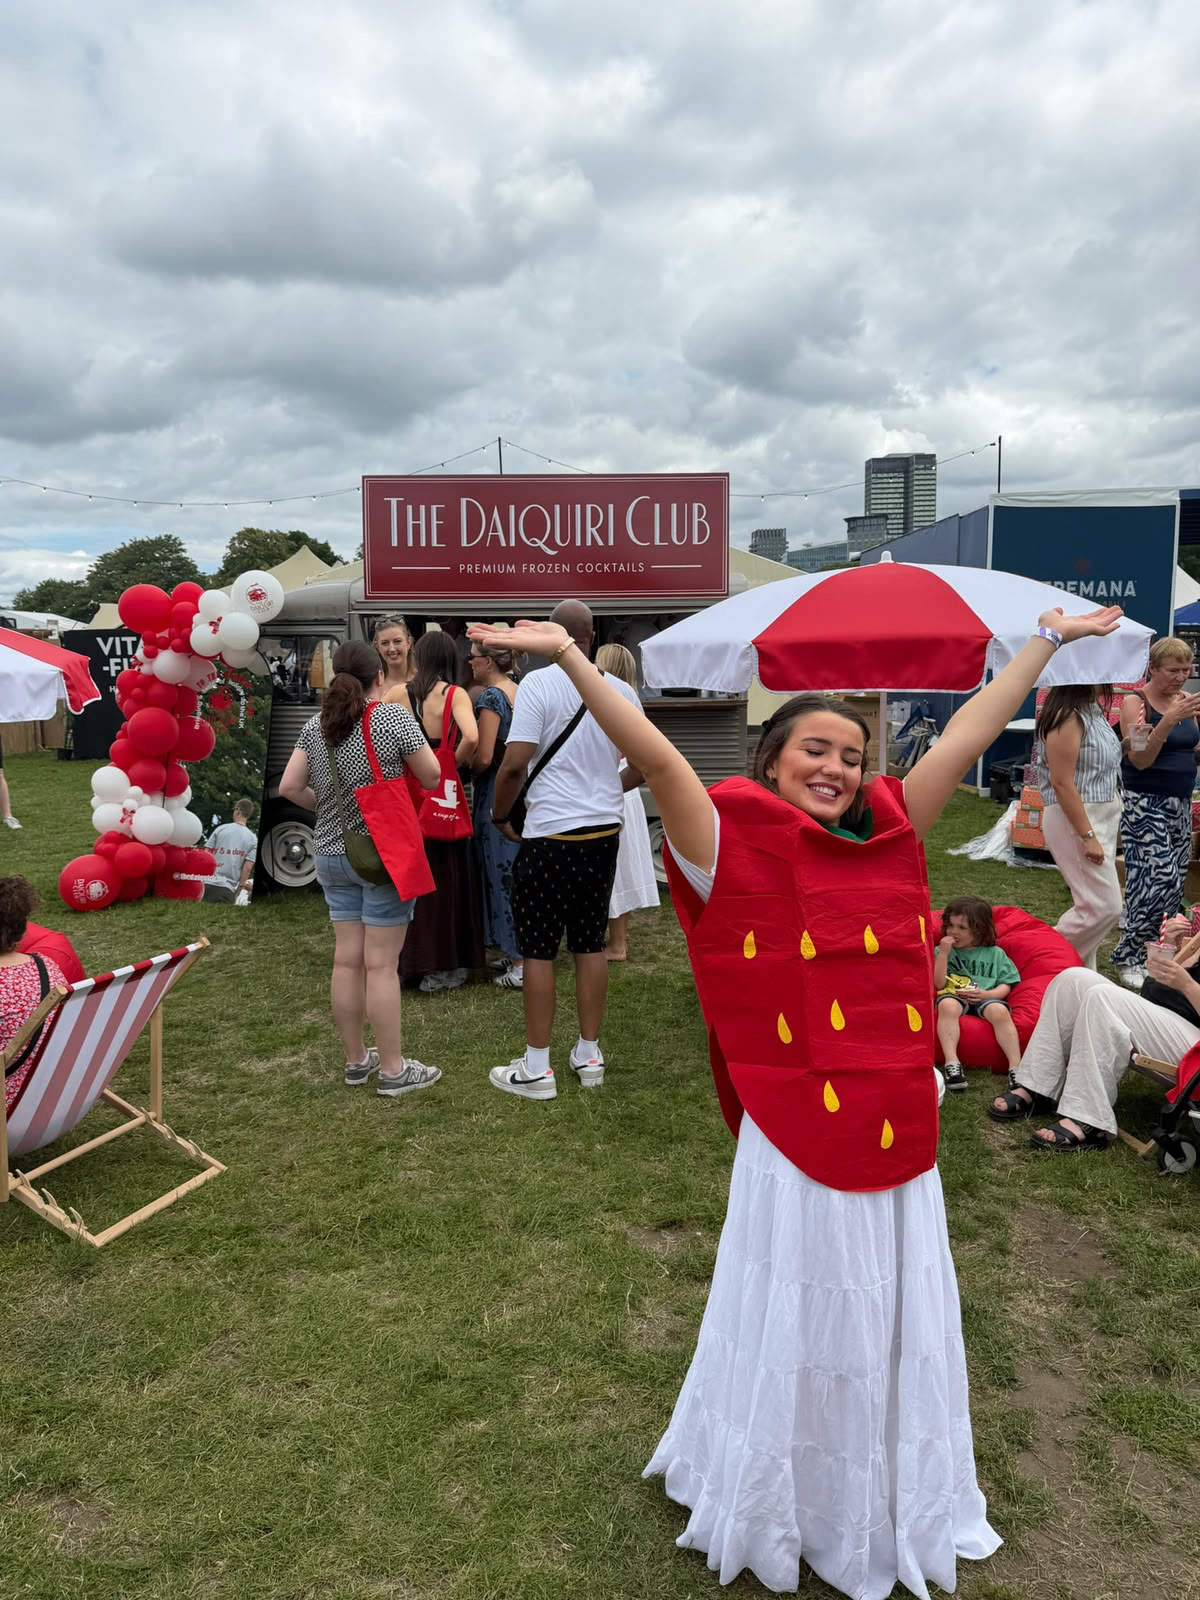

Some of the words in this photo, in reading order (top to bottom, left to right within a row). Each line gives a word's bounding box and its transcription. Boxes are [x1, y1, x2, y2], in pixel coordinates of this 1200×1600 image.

[383, 497, 446, 547] THE
[460, 497, 614, 555] DAIQUIRI
[625, 495, 711, 547] CLUB
[459, 563, 516, 574] PREMIUM
[522, 563, 570, 573] FROZEN
[576, 562, 645, 573] COCKTAILS
[1041, 580, 1137, 597] EMANA
